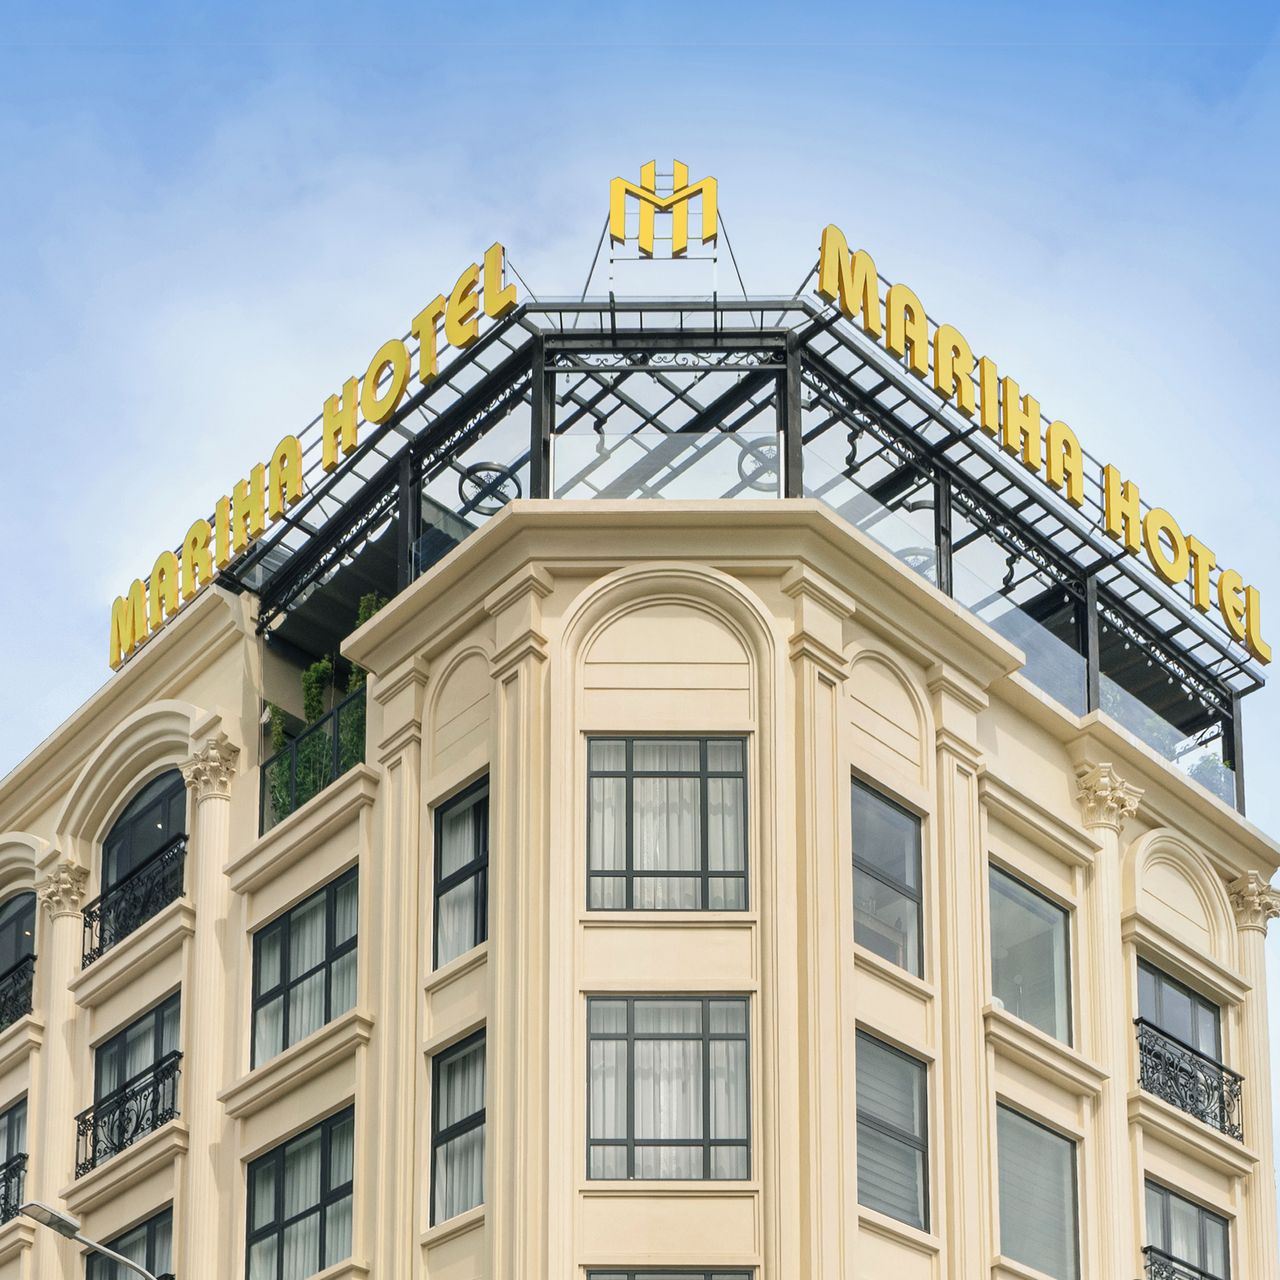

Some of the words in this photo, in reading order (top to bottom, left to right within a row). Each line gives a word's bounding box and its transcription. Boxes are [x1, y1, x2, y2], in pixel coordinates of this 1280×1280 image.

[109, 435, 303, 671] MARIHA
[322, 242, 517, 472] HOTEL
[818, 224, 1084, 508] MARIHA
[1104, 464, 1271, 665] HOTEL
